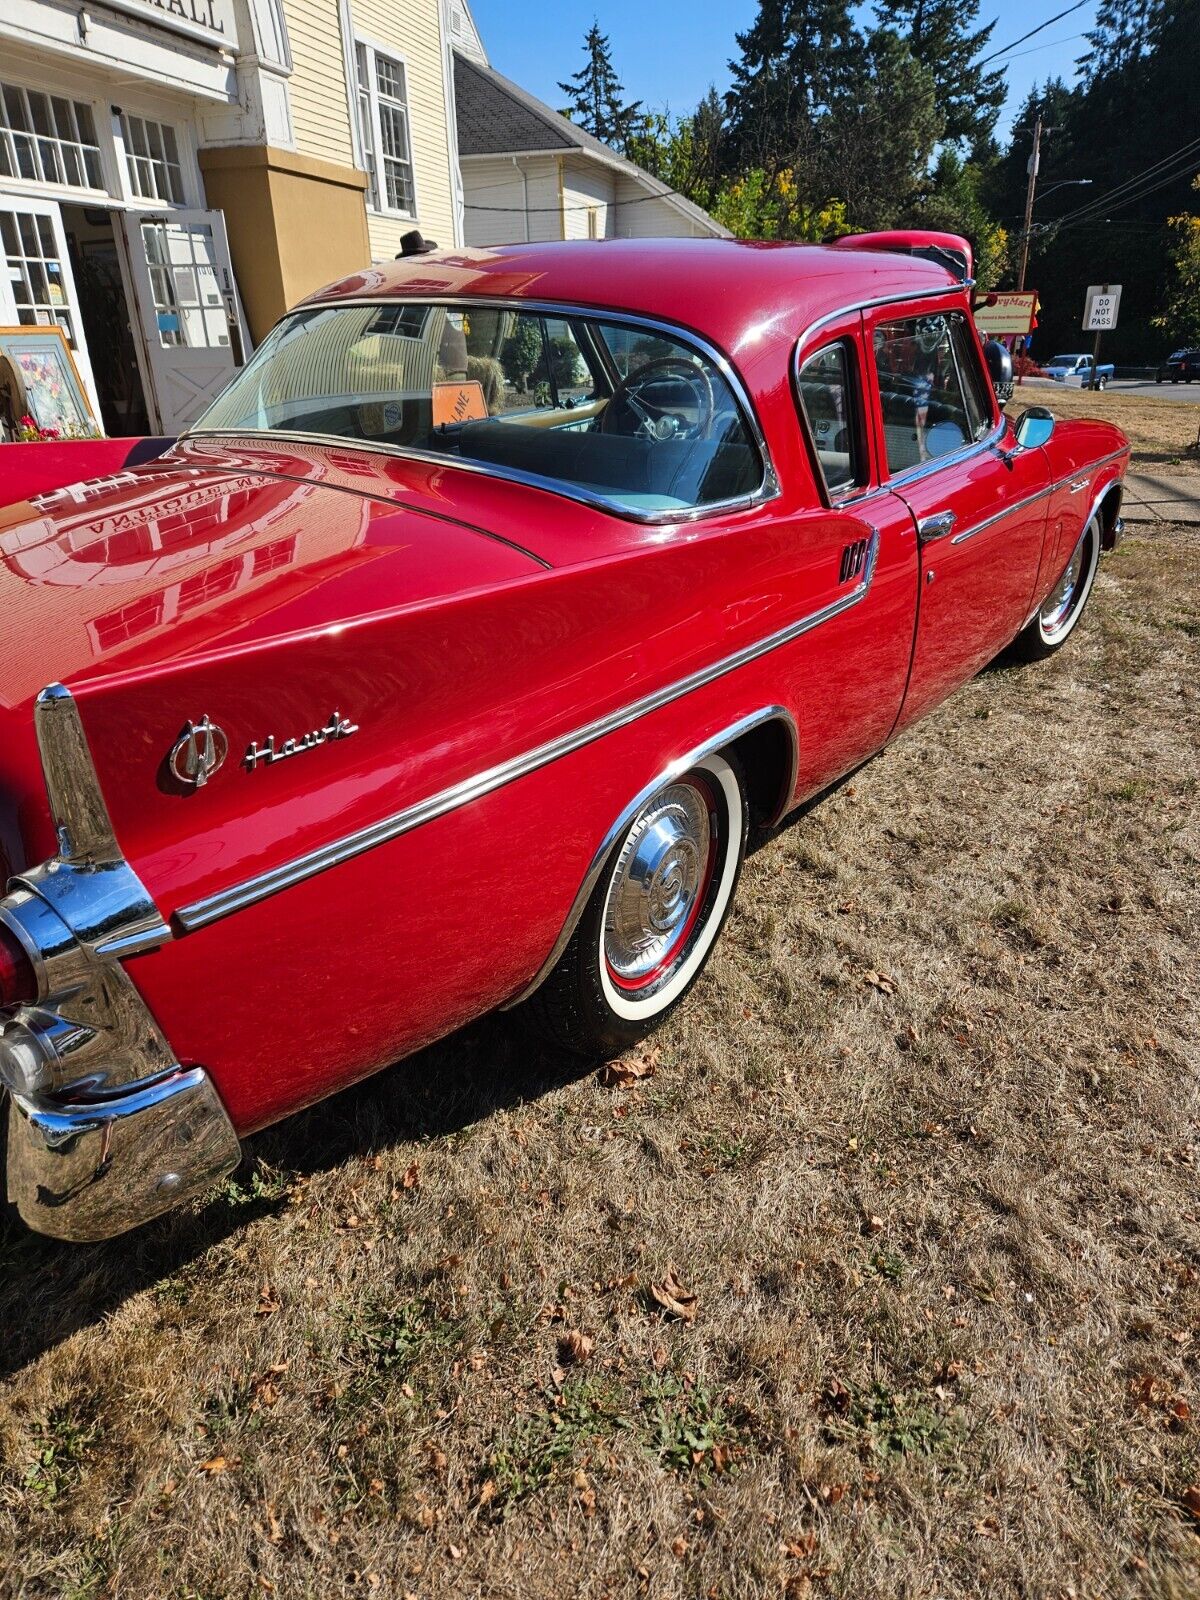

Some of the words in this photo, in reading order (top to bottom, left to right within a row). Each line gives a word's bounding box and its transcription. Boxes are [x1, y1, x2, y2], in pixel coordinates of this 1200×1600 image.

[142, 0, 225, 34] ALL
[1099, 298, 1110, 306] DO
[1095, 308, 1110, 316] NOT
[1091, 317, 1111, 325] PASS
[245, 711, 359, 769] Hawk
